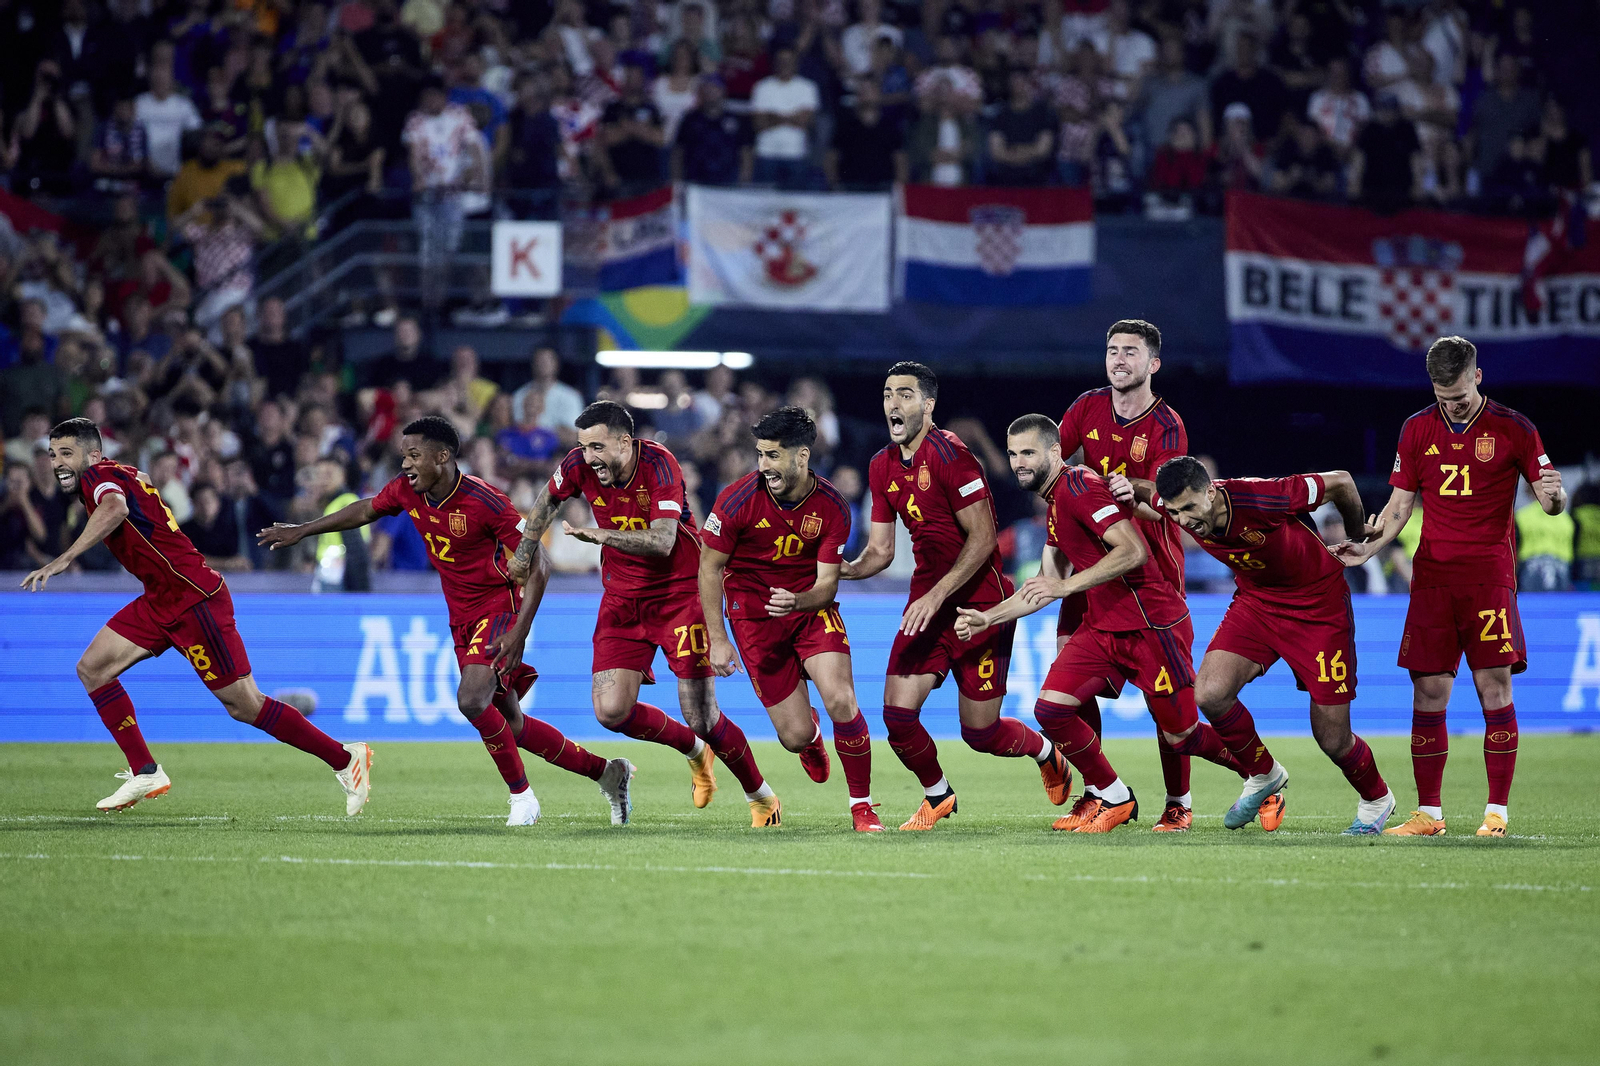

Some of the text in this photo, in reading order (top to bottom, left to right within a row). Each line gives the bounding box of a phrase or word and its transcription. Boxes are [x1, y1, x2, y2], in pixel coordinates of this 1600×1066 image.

[509, 237, 543, 279] K
[1244, 264, 1367, 323] BELE
[1440, 464, 1473, 496] 21
[906, 493, 924, 522] 6
[424, 532, 455, 563] 12
[772, 533, 806, 561] 10
[1478, 607, 1512, 642] 21
[674, 623, 708, 659] 20
[978, 649, 994, 680] 6
[1154, 665, 1174, 695] 4
[1316, 649, 1347, 683] 16
